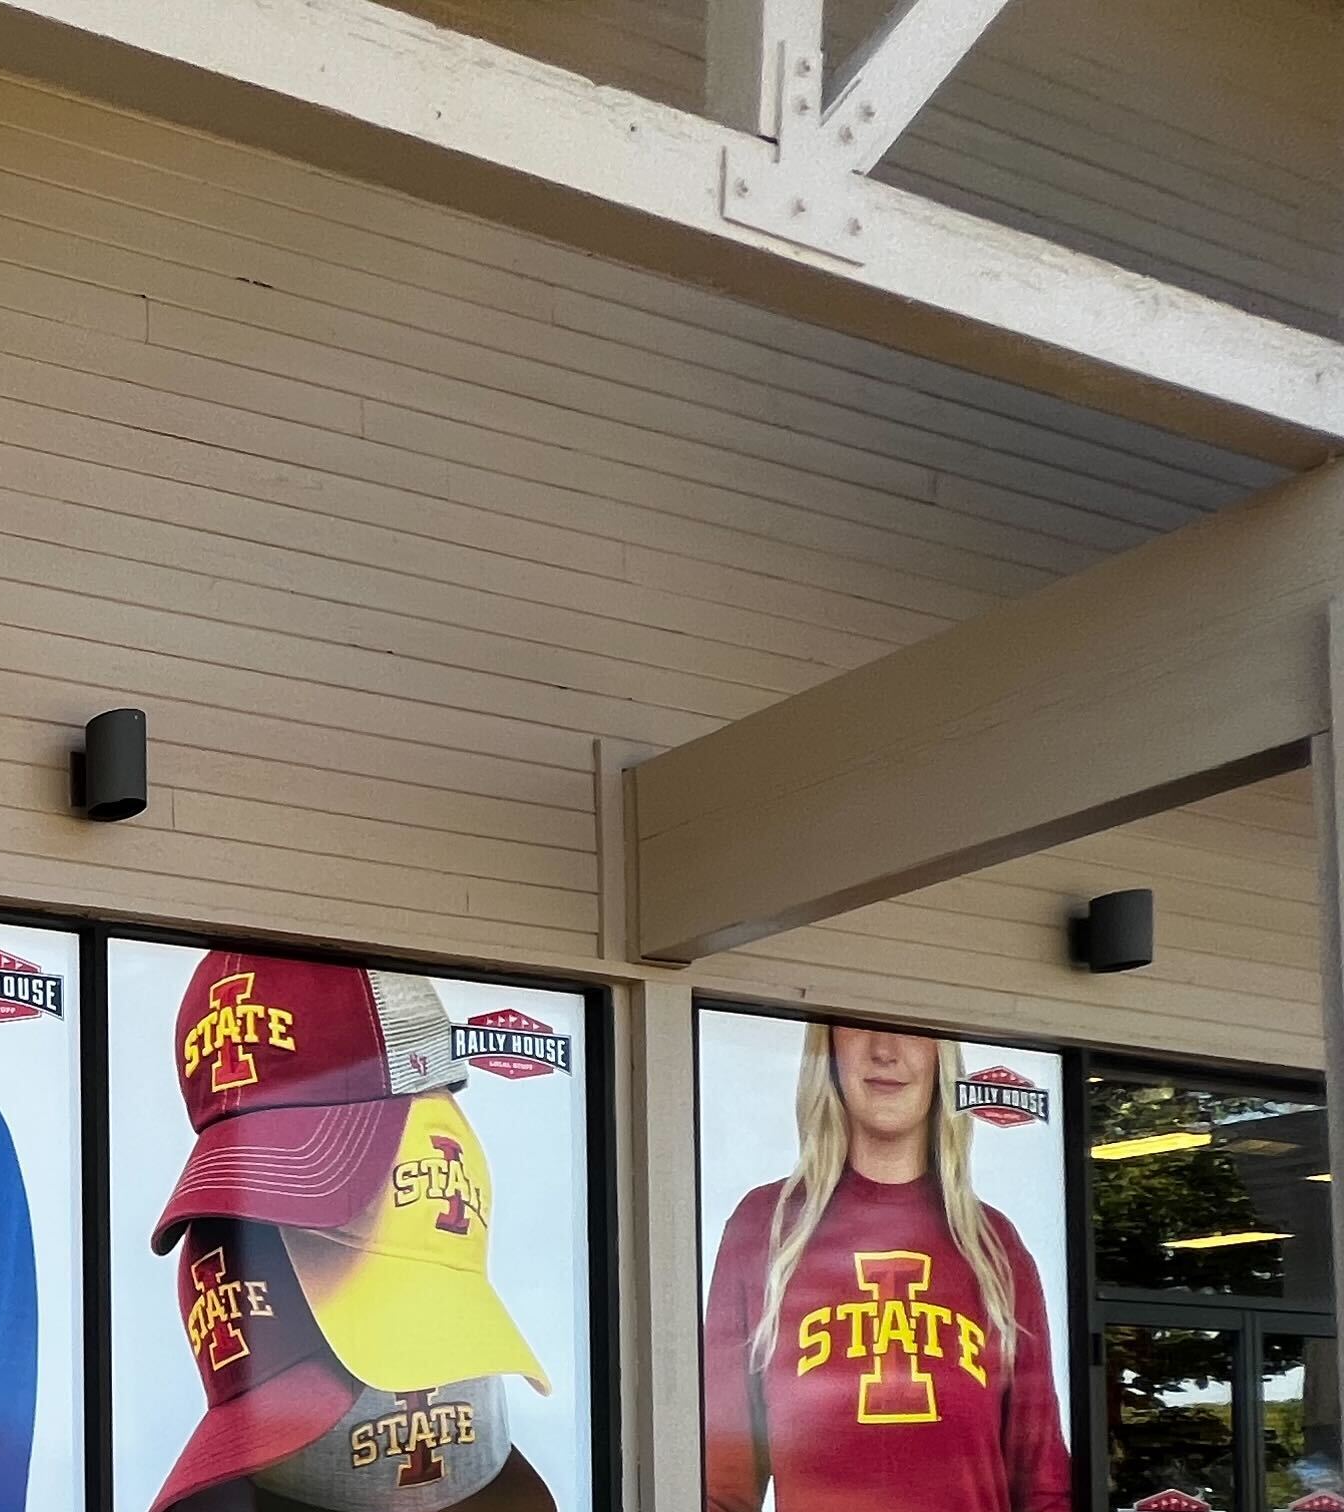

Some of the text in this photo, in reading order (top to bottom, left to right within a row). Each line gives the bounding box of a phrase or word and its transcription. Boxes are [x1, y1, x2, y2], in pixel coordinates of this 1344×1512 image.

[184, 1004, 296, 1078] STATE
[456, 1029, 567, 1067] RALLY HOUSE
[959, 1083, 1045, 1117] RALLY HOUSE
[187, 1280, 274, 1358] STATE
[797, 1300, 988, 1389] STATE
[350, 1402, 477, 1468] STATE
